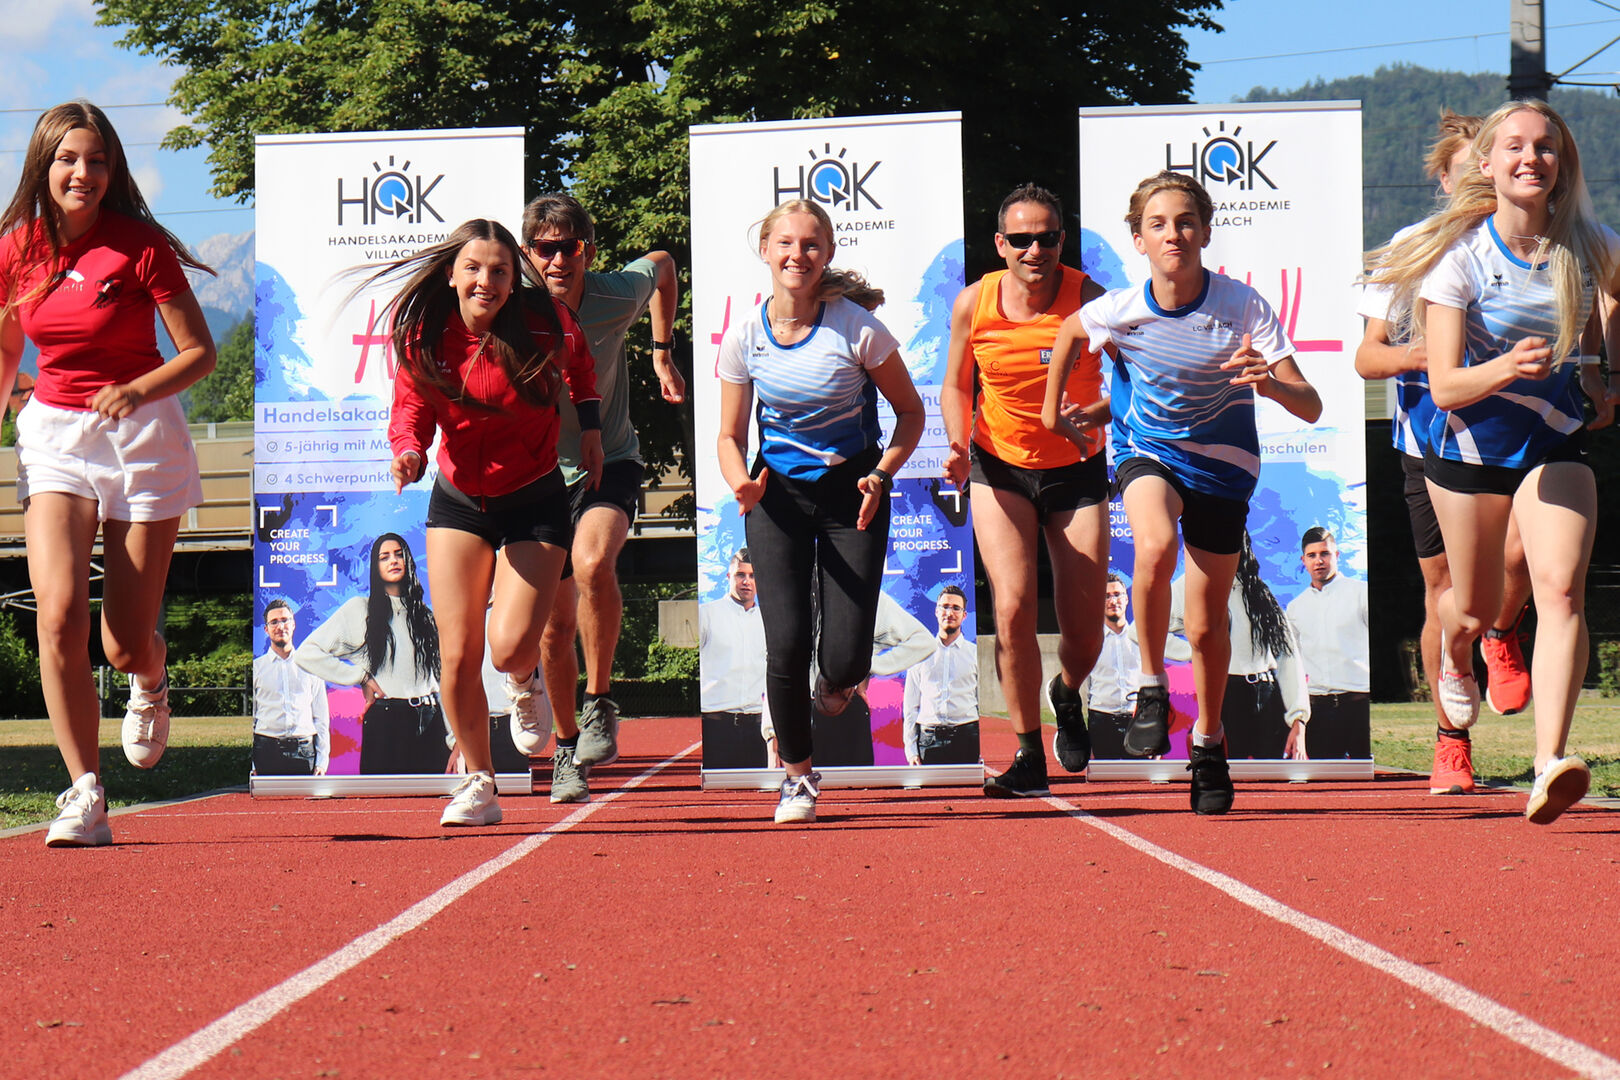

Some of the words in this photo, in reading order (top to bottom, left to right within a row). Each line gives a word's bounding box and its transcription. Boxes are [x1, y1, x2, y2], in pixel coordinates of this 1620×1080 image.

[1212, 200, 1291, 212] SAKADEMIE
[328, 233, 450, 246] HANDELSAKADEMI
[263, 407, 390, 424] Handelsakad
[284, 439, 340, 453] 5-jährig
[344, 440, 366, 450] mit
[1260, 442, 1328, 454] hschulen
[284, 474, 294, 485] 4
[892, 515, 932, 526] CREATE
[269, 529, 310, 539] CREATE
[892, 528, 923, 538] YOUR
[269, 542, 300, 552] YOUR
[893, 540, 952, 551] PROGRESS.
[270, 553, 328, 565] PROGRESS.
